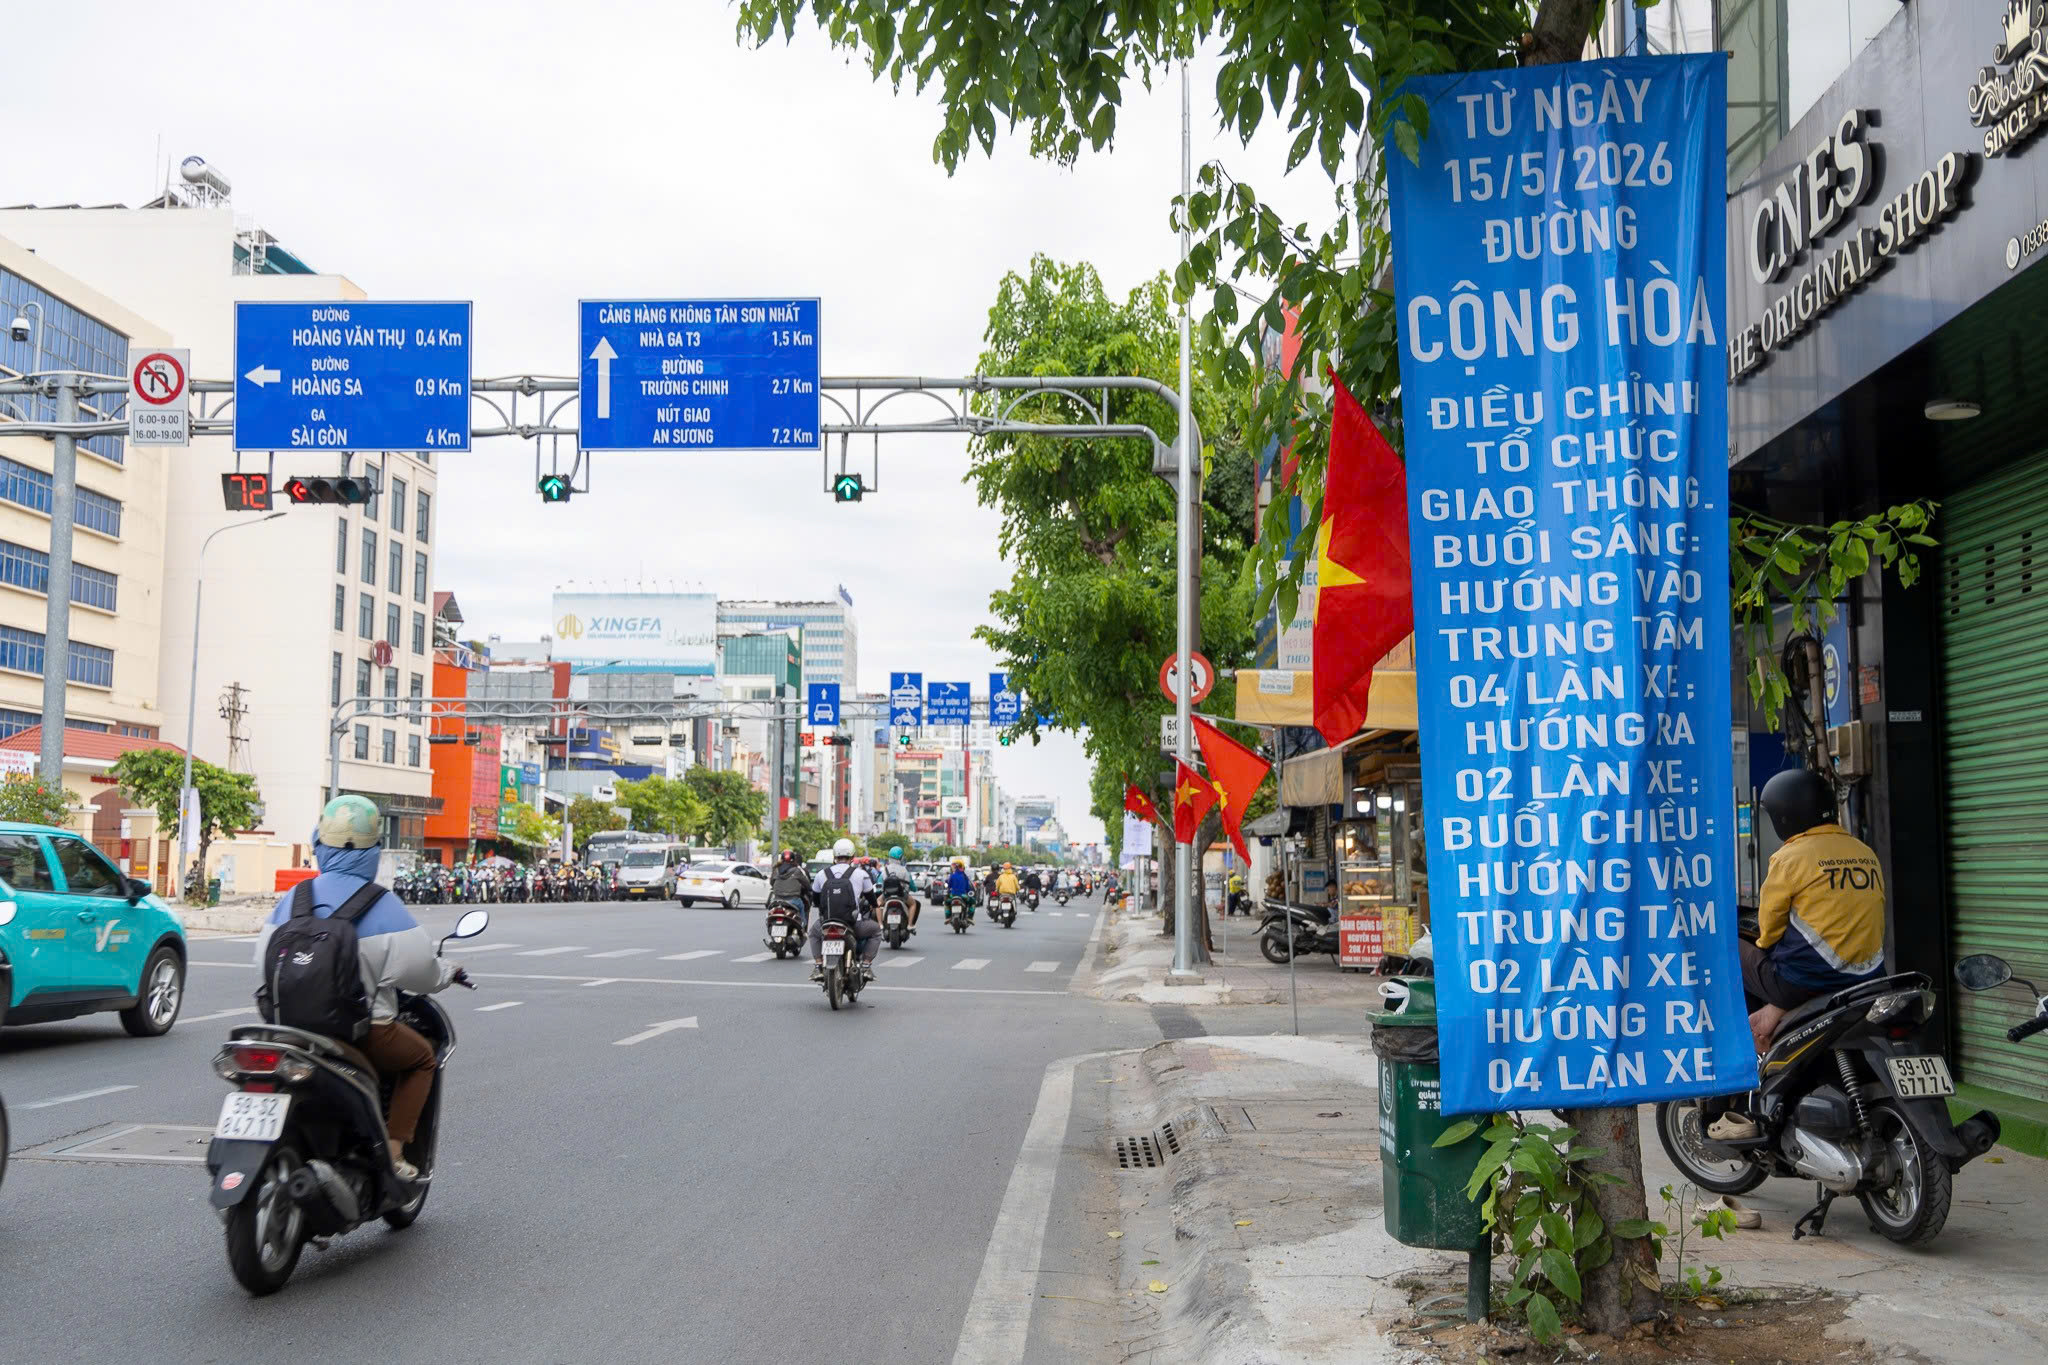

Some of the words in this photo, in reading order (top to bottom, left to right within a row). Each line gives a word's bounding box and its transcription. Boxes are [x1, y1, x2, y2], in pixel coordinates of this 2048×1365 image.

[1457, 80, 1516, 139] TỪ
[1534, 69, 1652, 132] NGÀY
[1984, 102, 2028, 158] SINCE
[1444, 141, 1673, 203] 15/5/2026
[1750, 109, 1864, 284] CNES
[1481, 200, 1637, 264] ĐƯỜNG
[1726, 322, 1756, 380] HE
[1760, 227, 1874, 352] ORIGINAL
[1878, 151, 1958, 256] SHOP
[312, 306, 350, 322] ĐƯỜNG
[599, 304, 631, 324] CẢNG
[634, 304, 667, 324] HÀNG
[670, 304, 712, 324] KHÔNG
[714, 305, 738, 323] TÂN
[741, 306, 766, 323] SƠN
[769, 302, 800, 323] NHẤT
[1407, 279, 1580, 376] CỘNG
[1604, 260, 1717, 346] HÒA
[292, 325, 342, 347] HOÀNG
[344, 325, 374, 347] VĂN
[377, 328, 406, 350] THỤ
[439, 328, 462, 347] Km
[639, 328, 665, 347] NHÀ
[667, 332, 684, 347] GA
[686, 331, 701, 347] T3
[793, 331, 813, 346] Km
[292, 374, 342, 396] HOÀNG
[344, 378, 363, 396] SA
[439, 378, 462, 396] Km
[312, 355, 350, 372] ĐƯỜNG
[640, 376, 689, 396] TRƯỜNG
[692, 380, 729, 396] CHINH
[793, 379, 813, 394] Km
[662, 355, 704, 375] ĐƯỜNG
[311, 408, 326, 422] GA
[657, 403, 681, 423] NÚT
[683, 407, 711, 423] GIAO
[1427, 383, 1544, 430] ĐIỀU
[1565, 371, 1699, 420] CHỈNH
[291, 425, 315, 446] SÀI
[317, 424, 348, 446] GÒN
[425, 429, 436, 446] 4
[438, 429, 461, 446] Km
[652, 429, 670, 444] AN
[672, 428, 714, 444] SƯƠNG
[793, 429, 813, 444] Km
[1466, 426, 1533, 474] TỔ
[1551, 419, 1679, 468] CHỨC
[230, 475, 267, 509] 72
[1421, 485, 1535, 522] GIAO
[1433, 519, 1551, 569] BUỔI
[1570, 512, 1700, 560] SÁNG:
[1440, 569, 1620, 615] HƯỚNG
[1636, 561, 1702, 604] VÀO
[589, 616, 662, 632] XINGFA
[1438, 618, 1614, 661] TRUNG
[1631, 610, 1703, 650] TÂM
[1449, 672, 1509, 708] 04
[1527, 660, 1625, 705] LÀN
[1465, 708, 1645, 755] HƯỚNG
[1656, 712, 1695, 746] RA
[1455, 766, 1514, 802] 02
[1531, 754, 1630, 800] LÀN
[1442, 800, 1560, 851] BUỔI
[1581, 797, 1714, 845] CHIỀU:
[1458, 851, 1632, 897] HƯỚNG
[1647, 847, 1712, 891] VÀO
[1457, 907, 1625, 945] TRUNG
[1640, 897, 1716, 939] TÂM
[1469, 959, 1521, 994] 02
[1541, 947, 1631, 993] LÀN
[1647, 951, 1711, 988] XE;
[1486, 996, 1646, 1044] HƯỚNG
[1665, 999, 1715, 1035] RA
[1488, 1057, 1542, 1094] 04
[1557, 1045, 1647, 1091] LÀN
[1664, 1047, 1716, 1083] XE
